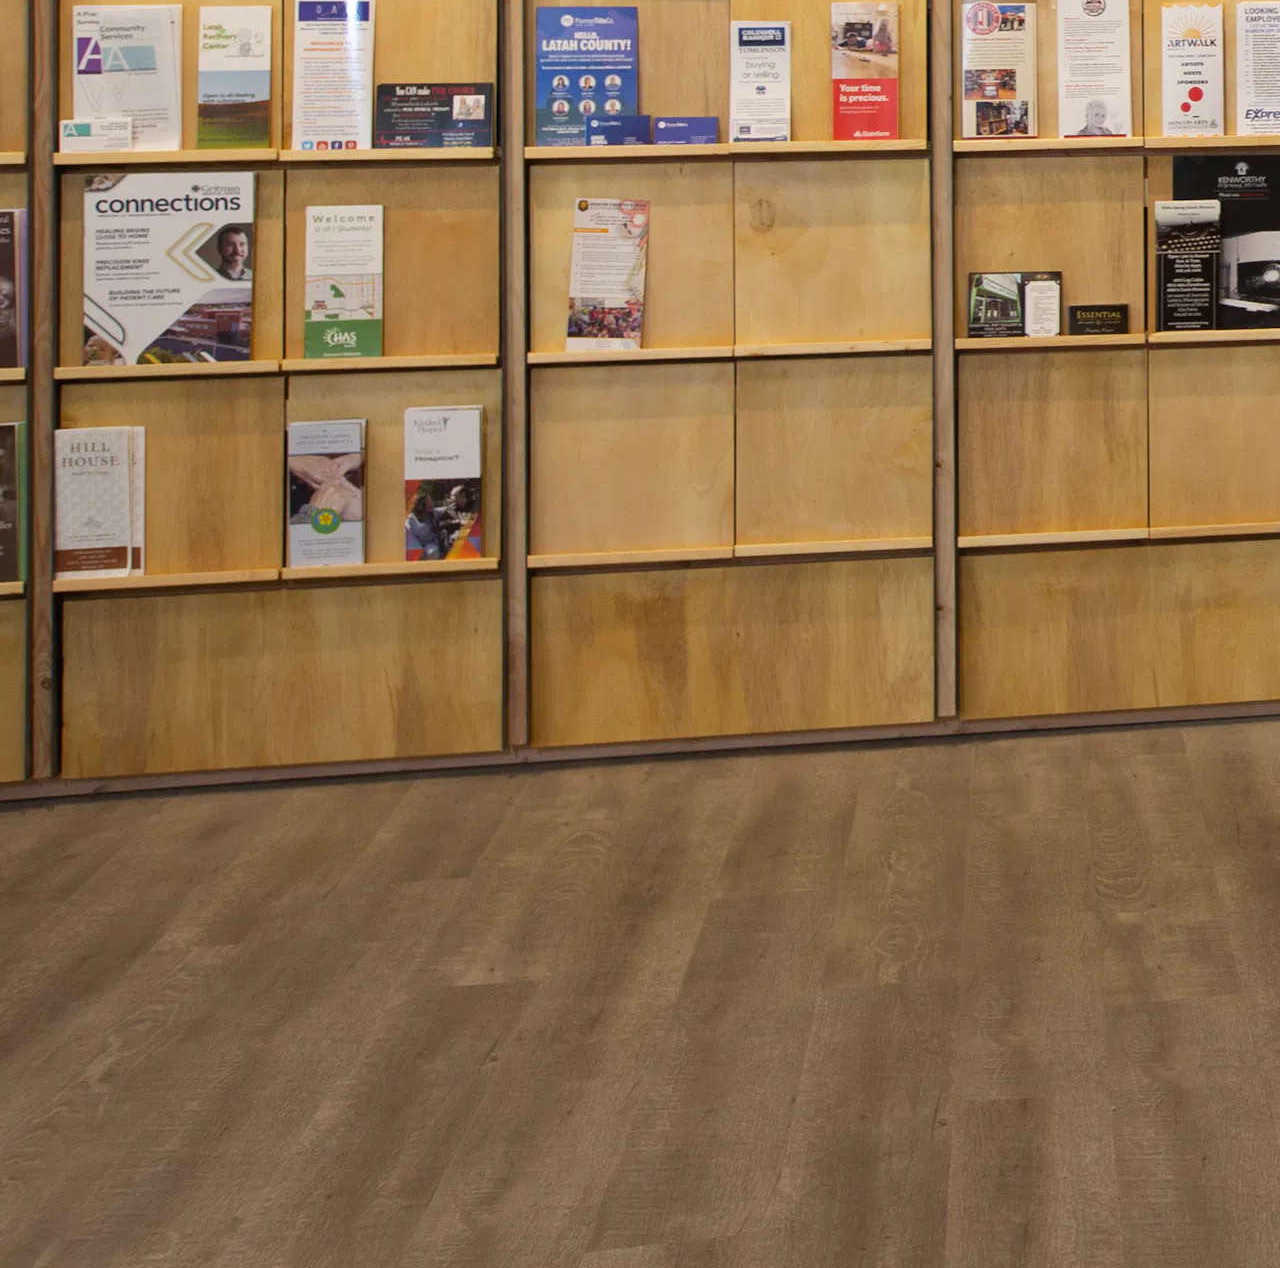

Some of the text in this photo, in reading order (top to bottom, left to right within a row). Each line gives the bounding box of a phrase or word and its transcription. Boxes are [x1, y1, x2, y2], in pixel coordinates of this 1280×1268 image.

[1244, 7, 1278, 15] LOOKING
[100, 24, 146, 34] Community
[101, 33, 134, 41] Services
[542, 39, 632, 52] LATAH COUNTY!
[1167, 39, 1218, 48] ARTWALK
[745, 60, 776, 70] buying
[752, 71, 780, 80] selling
[839, 84, 882, 93] Your time
[839, 93, 889, 104] is precious.
[1217, 176, 1267, 184] KENWORTHY
[95, 194, 241, 214] connections
[312, 214, 375, 224] Welcome
[1076, 310, 1122, 319] ESSENTIAL
[328, 330, 358, 346] CHAS
[70, 442, 112, 453] HILL
[61, 455, 120, 468] HOUSE
[415, 454, 460, 463] Hospice?
